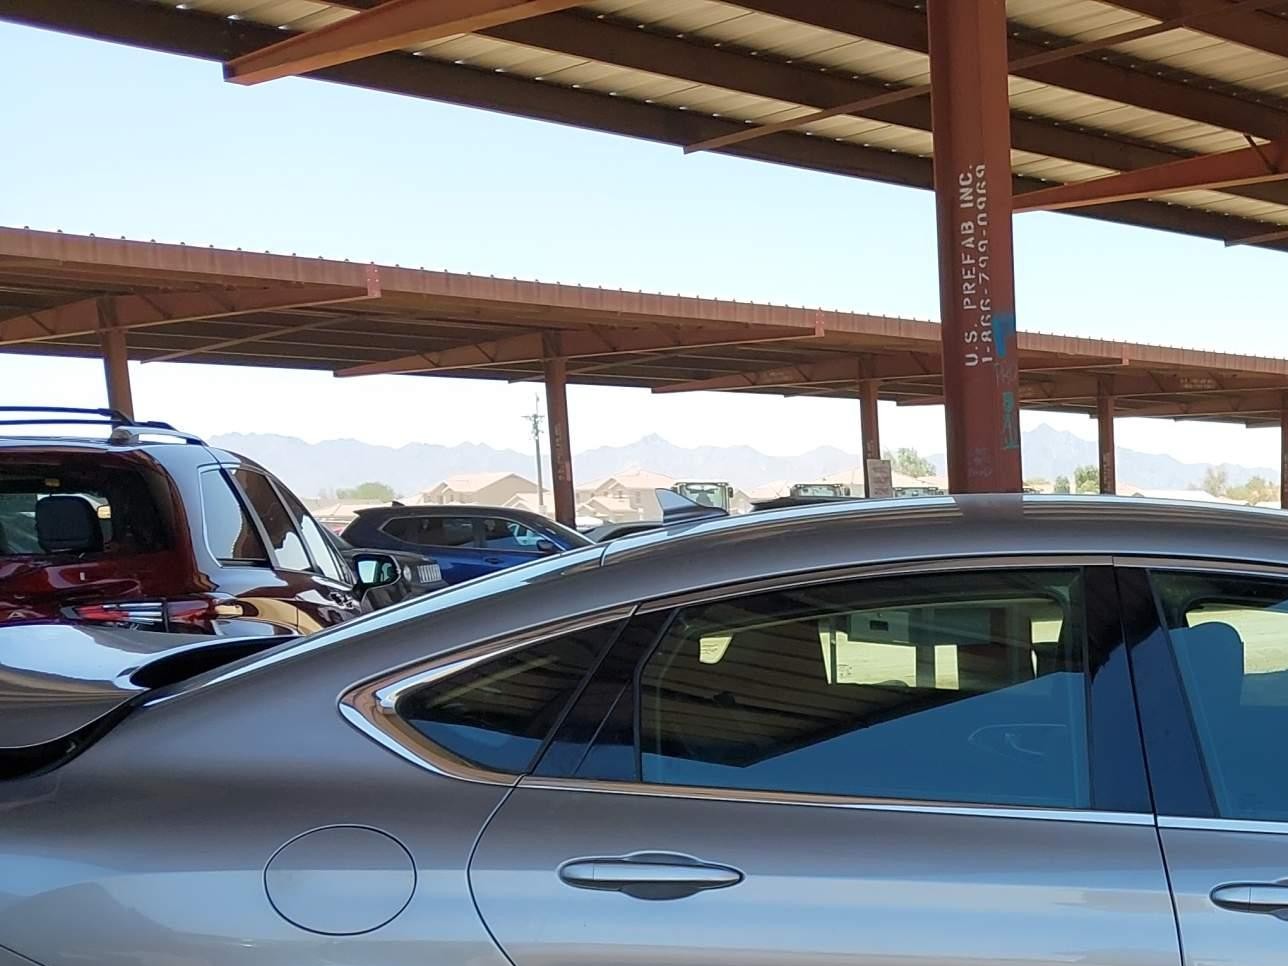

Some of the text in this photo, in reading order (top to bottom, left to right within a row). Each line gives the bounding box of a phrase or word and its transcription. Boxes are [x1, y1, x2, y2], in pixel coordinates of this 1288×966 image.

[959, 164, 979, 367] U.S. PREFAB INC.
